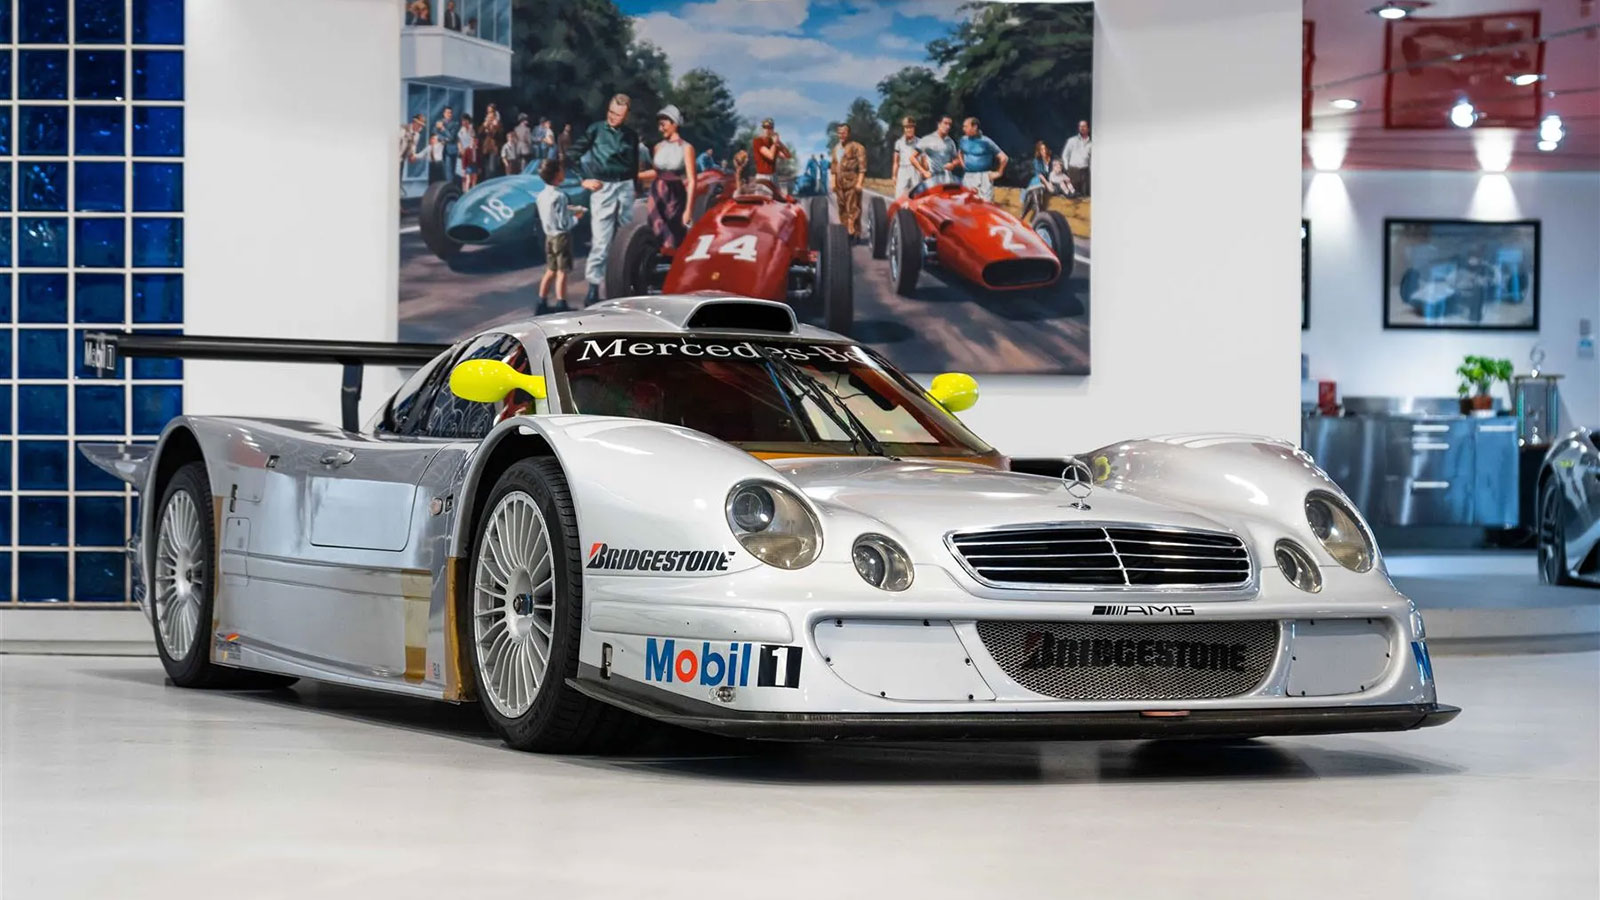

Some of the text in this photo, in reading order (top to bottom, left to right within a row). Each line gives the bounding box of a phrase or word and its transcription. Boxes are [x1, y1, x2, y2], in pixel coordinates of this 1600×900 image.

[480, 198, 514, 222] 18
[684, 233, 758, 263] 14
[989, 225, 1026, 250] 2
[576, 338, 868, 364] Mercedes-Be
[586, 542, 735, 572] BRIDGESTONE
[1122, 604, 1195, 616] AMG
[644, 637, 752, 688] Mobil
[1021, 631, 1246, 672] BRIDGESTONE
